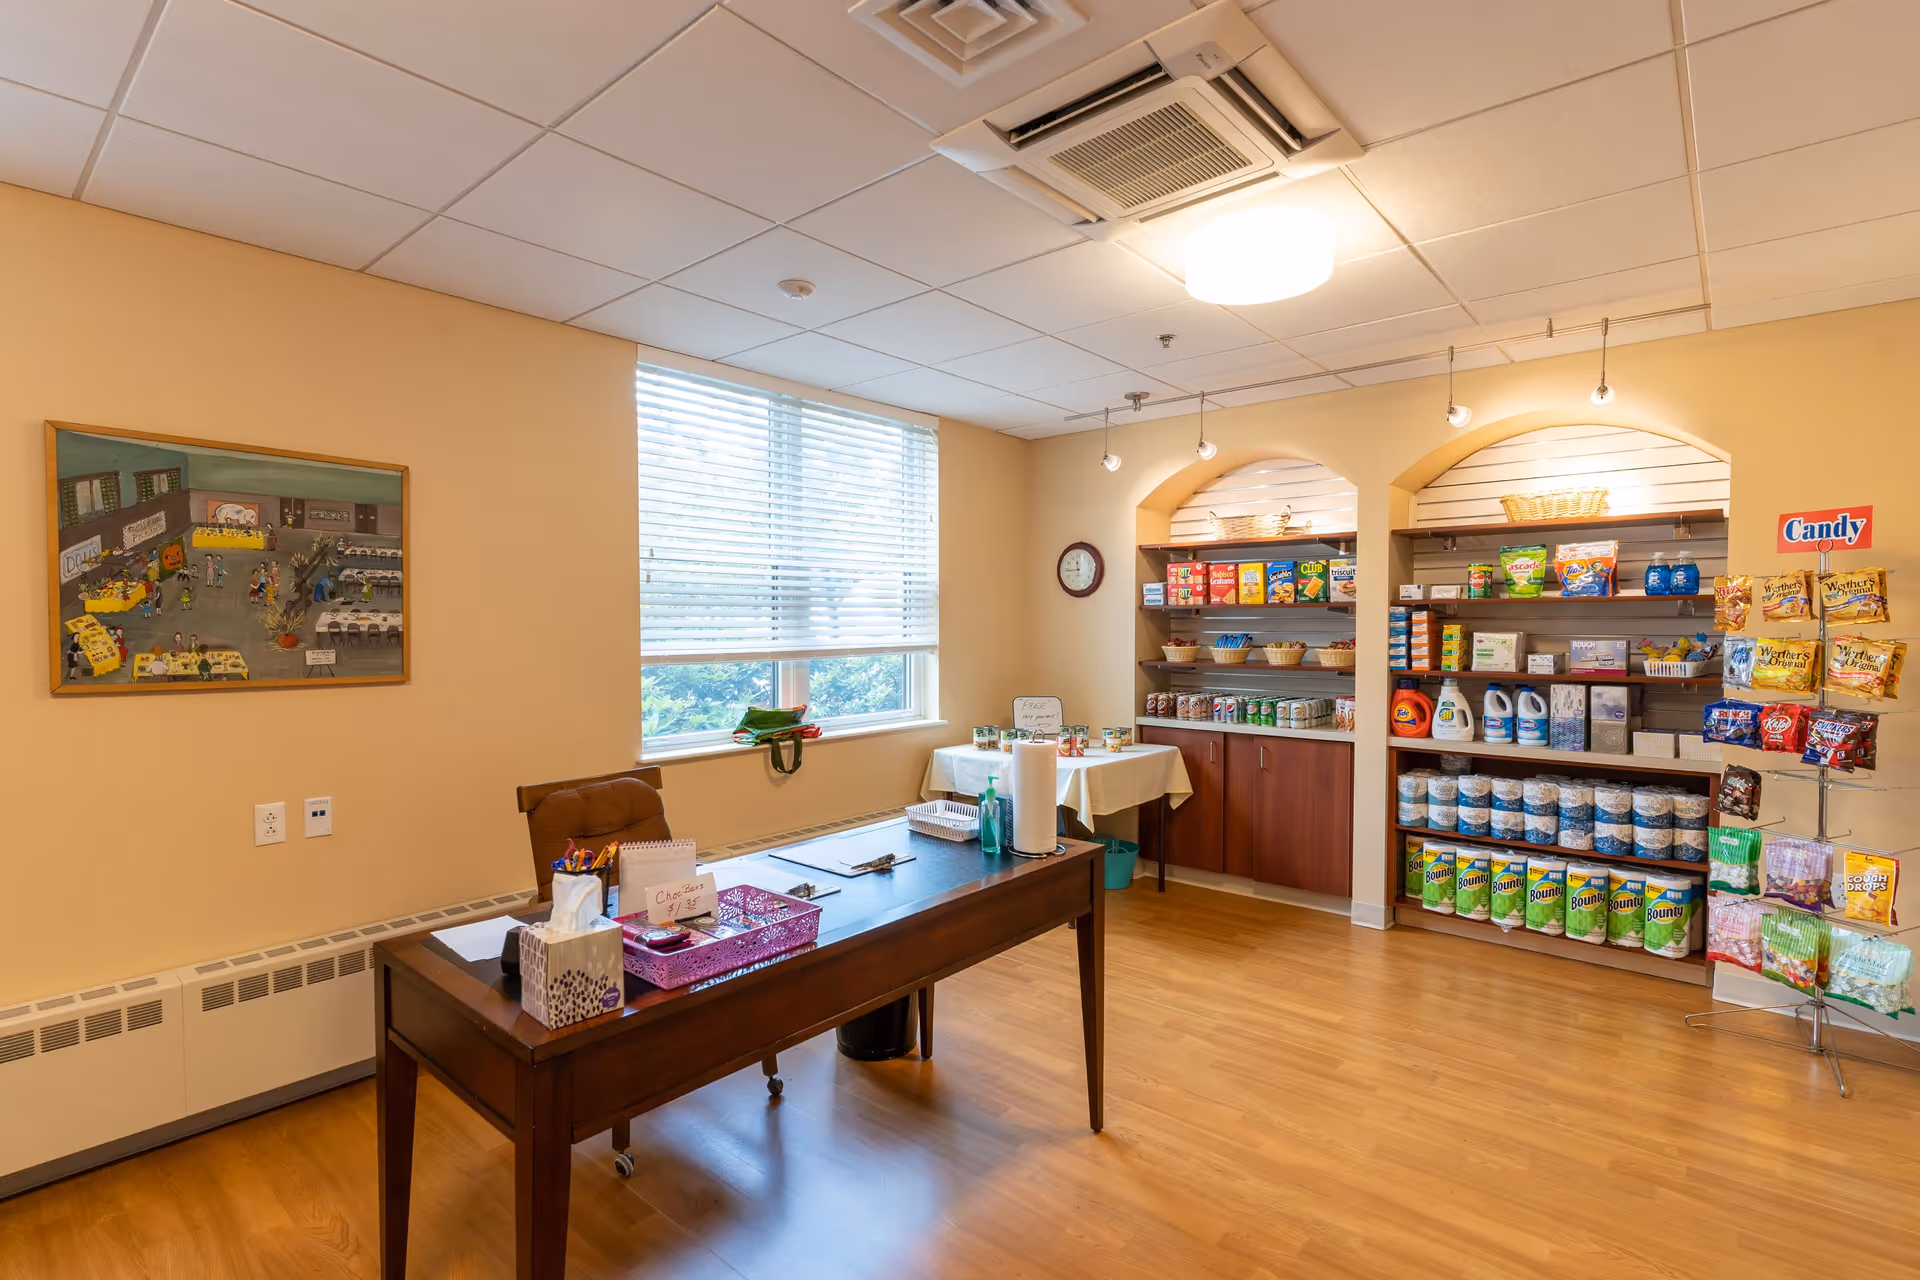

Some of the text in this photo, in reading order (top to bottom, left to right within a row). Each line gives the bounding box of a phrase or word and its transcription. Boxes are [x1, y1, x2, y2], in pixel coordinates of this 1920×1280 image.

[1784, 514, 1865, 544] Candy
[1178, 567, 1191, 578] RITZ
[1301, 564, 1323, 574] CLUB
[1331, 567, 1356, 576] triscuit
[1505, 560, 1542, 573] Cascade
[1566, 565, 1585, 576] Tide
[1212, 570, 1234, 578] Nabisco
[1268, 569, 1293, 583] Sociables
[1764, 579, 1803, 592] Werther's
[1824, 577, 1876, 591] Werther's
[1178, 588, 1192, 599] RITZ
[1717, 586, 1743, 598] Twix
[1774, 588, 1801, 599] Original
[1839, 585, 1874, 597] Original
[1759, 645, 1810, 660] Werther's
[1837, 645, 1886, 663] Werther
[1770, 657, 1807, 669] Original
[1846, 658, 1882, 672] Original
[1397, 709, 1409, 717] Tide
[1440, 709, 1453, 720] all
[1814, 720, 1855, 734] SNICKERS
[1409, 860, 1423, 873] Bou
[1426, 867, 1454, 884] Bounty
[1458, 874, 1488, 890] Bounty
[1847, 875, 1888, 883] COUGH
[1493, 878, 1524, 894] Bounty
[1847, 882, 1887, 891] DROPS
[656, 890, 683, 904] Choc
[1530, 886, 1563, 903] Bounty
[1571, 892, 1605, 910] Bounty
[1608, 896, 1643, 912] Bounty
[1647, 906, 1683, 922] Bounty
